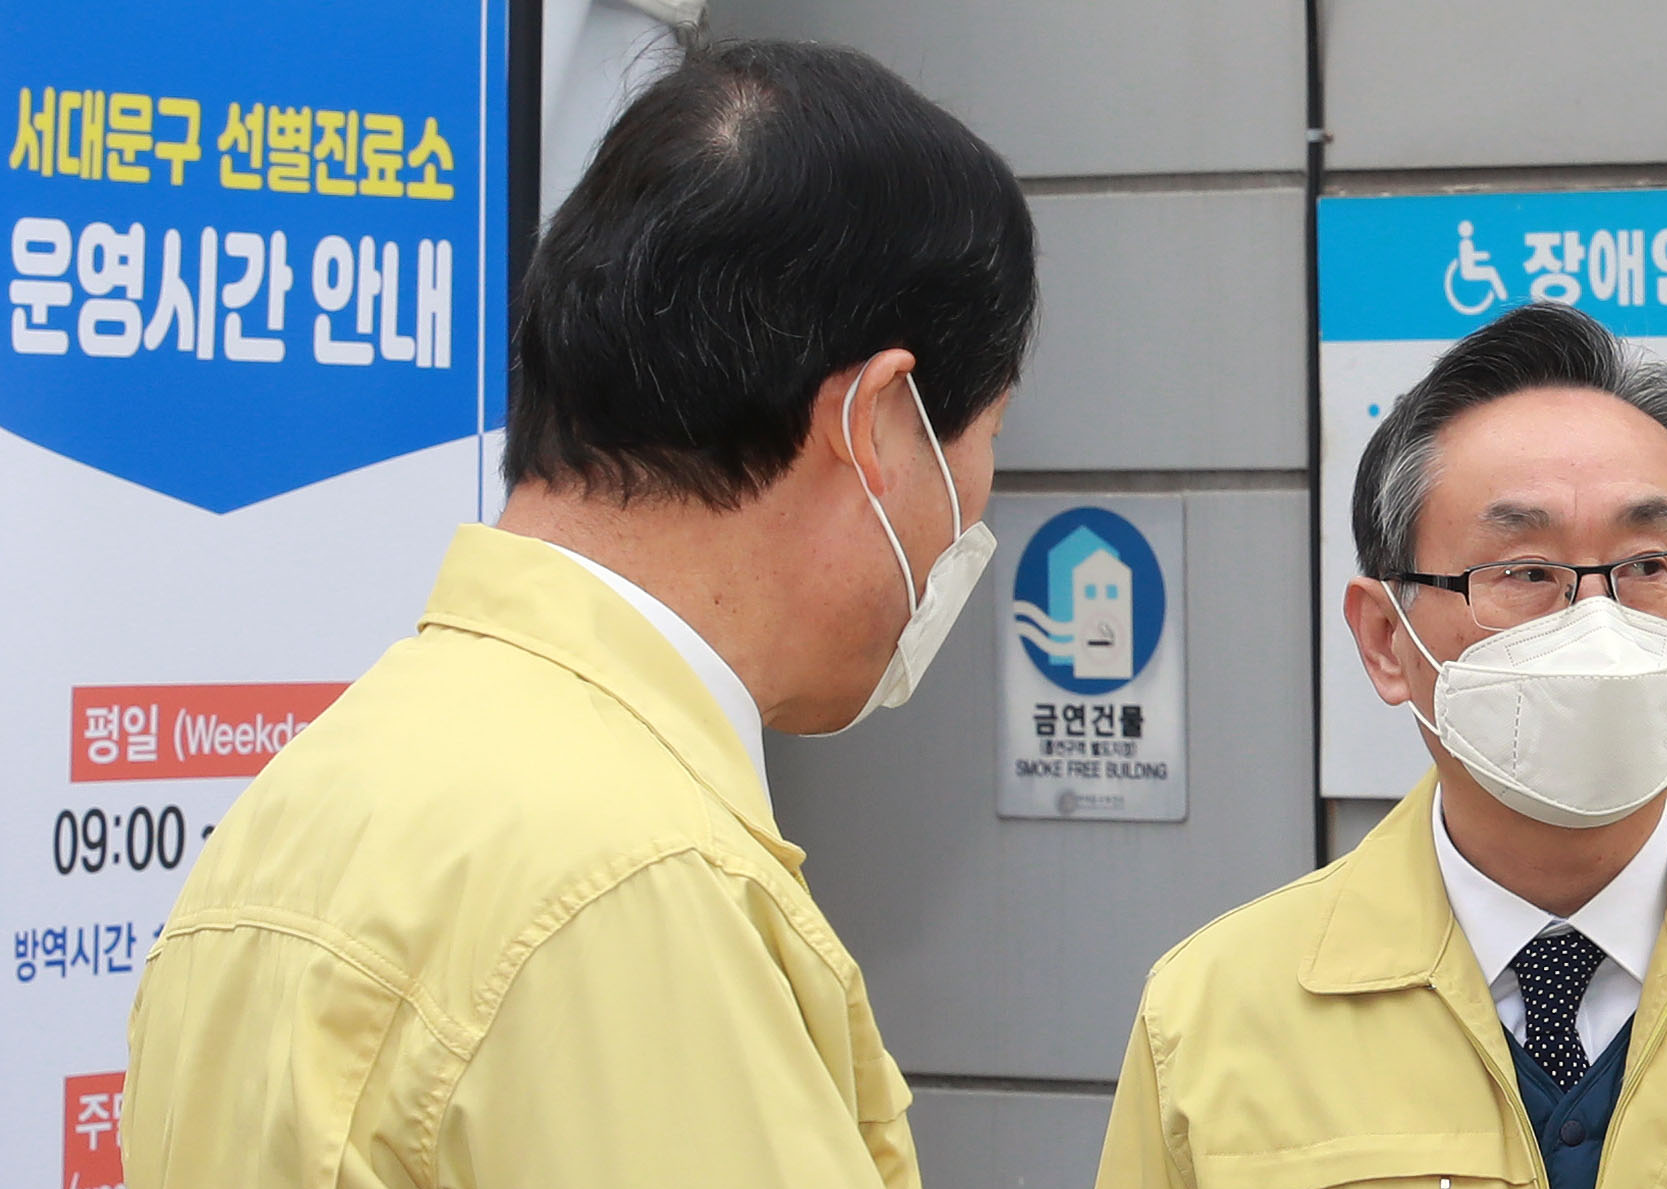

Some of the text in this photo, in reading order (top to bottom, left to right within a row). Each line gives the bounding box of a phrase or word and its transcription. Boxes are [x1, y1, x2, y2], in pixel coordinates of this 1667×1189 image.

[8, 86, 455, 201] 서대문구 선별진료소
[9, 216, 453, 369] 운영시간 안내
[83, 703, 159, 764] 평일
[1033, 703, 1144, 739] 금연건물
[1015, 758, 1169, 781] SMOKE FREE BUILDING
[54, 803, 186, 876] 09:00
[13, 921, 137, 984] 방역시간
